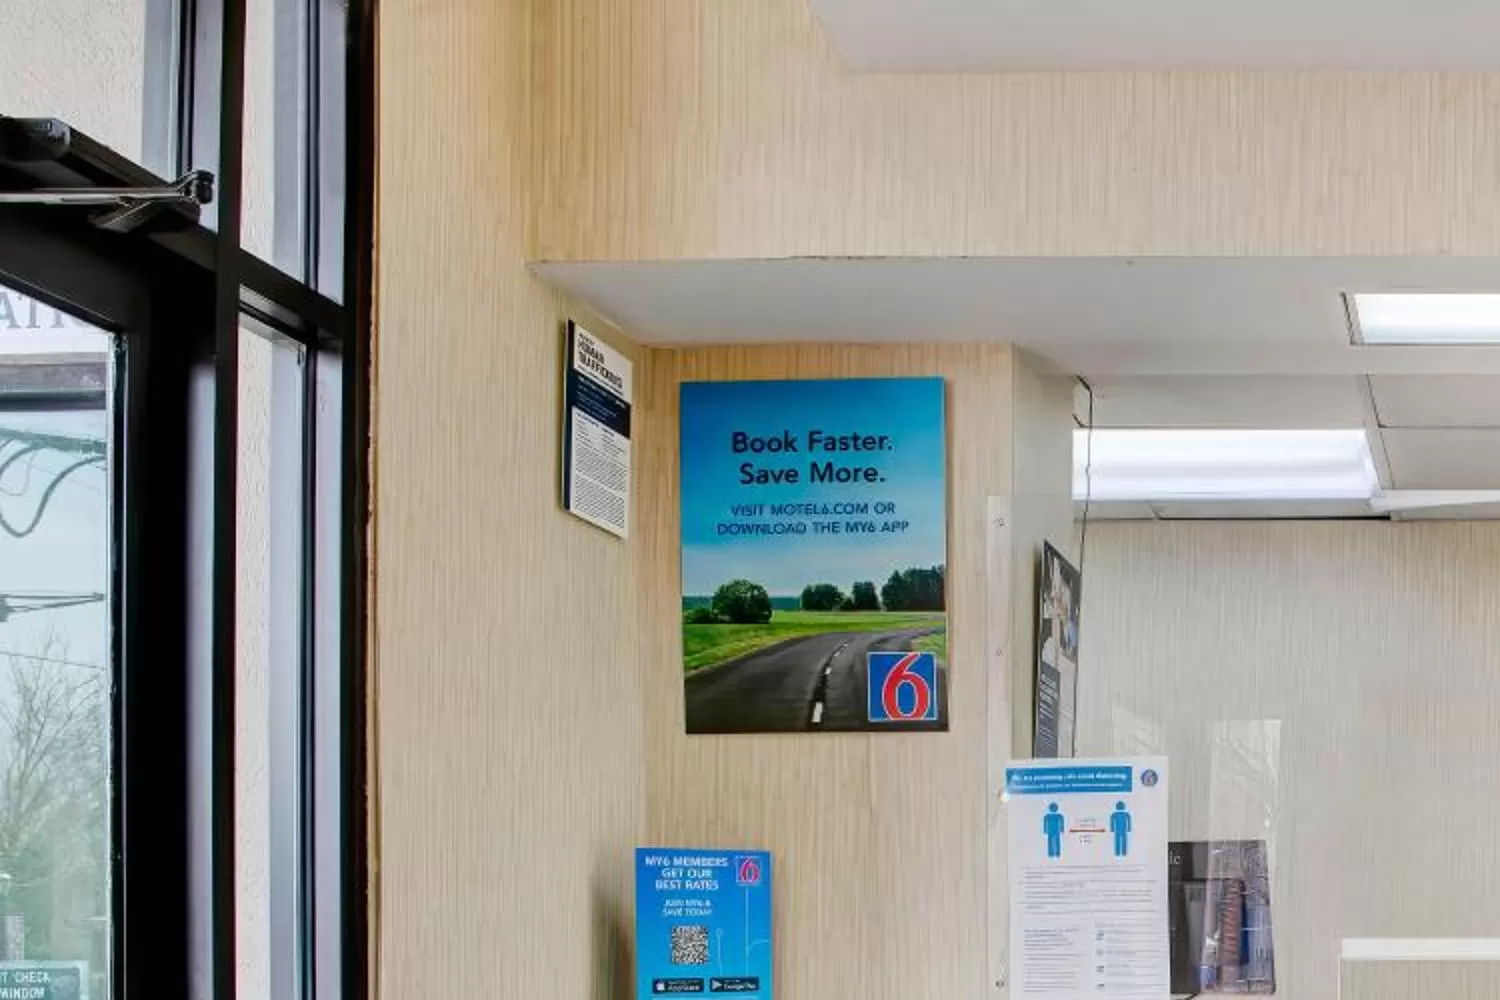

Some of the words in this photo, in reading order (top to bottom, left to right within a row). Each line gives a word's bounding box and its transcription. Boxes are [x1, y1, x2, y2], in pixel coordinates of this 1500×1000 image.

[732, 430, 800, 453] Book
[808, 429, 894, 453] Faster.
[739, 462, 800, 485] Save
[809, 461, 887, 484] More.
[731, 504, 763, 517] VISIT
[770, 503, 869, 517] MOTEL6.COM
[873, 502, 896, 515] OR
[717, 522, 807, 536] DOWNLOAD
[813, 521, 841, 535] THE
[845, 521, 877, 534] MY6
[880, 520, 910, 534] APP
[881, 652, 931, 720] 6
[645, 855, 671, 867] MY6
[673, 855, 728, 867] MEMBERS
[661, 868, 684, 879] GET
[687, 868, 713, 879] OUR
[655, 879, 681, 891] BEST
[685, 879, 719, 891] RATES
[15, 971, 50, 984] CHECK
[0, 987, 45, 1000] WINDOW
